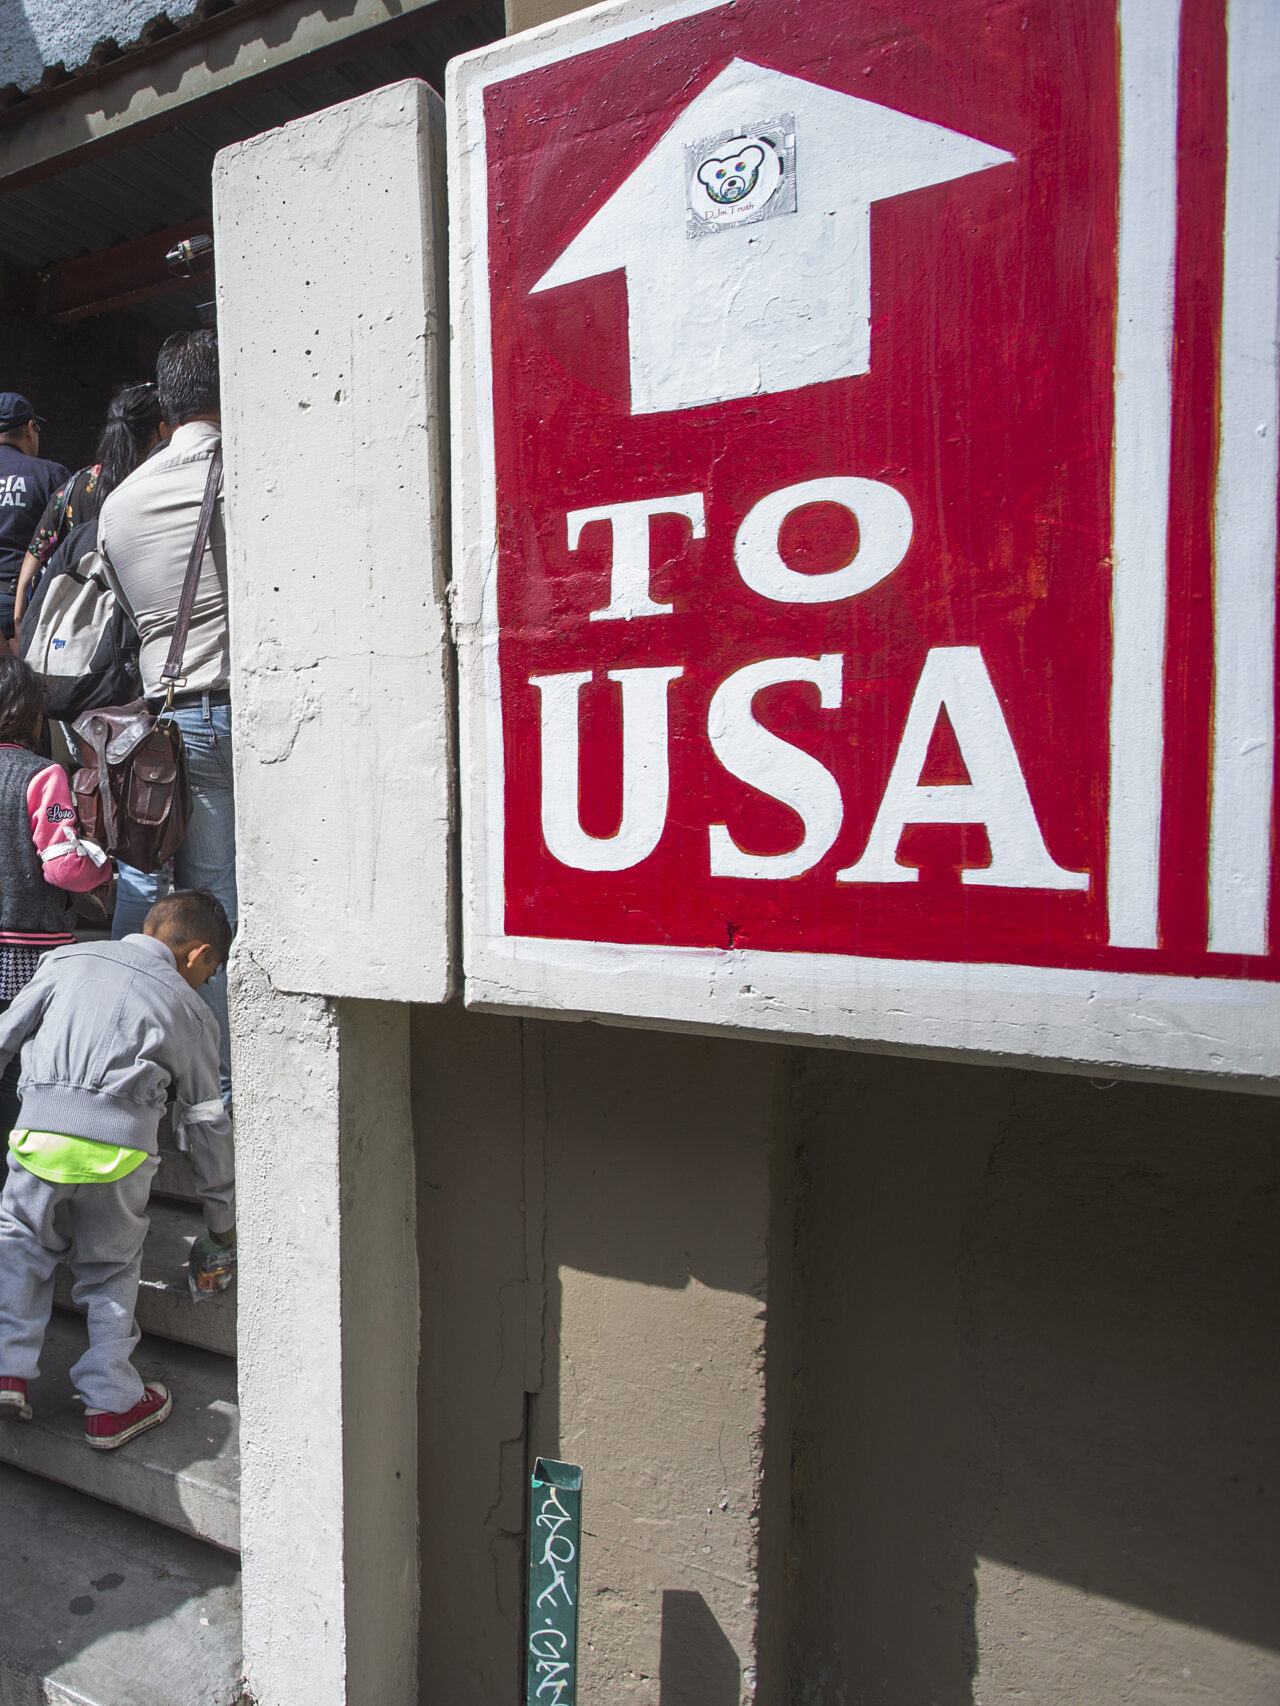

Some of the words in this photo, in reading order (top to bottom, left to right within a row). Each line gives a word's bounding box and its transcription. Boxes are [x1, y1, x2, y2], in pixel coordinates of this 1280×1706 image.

[566, 476, 913, 622] TO
[46, 804, 74, 823] Love
[528, 645, 1090, 890] USA
